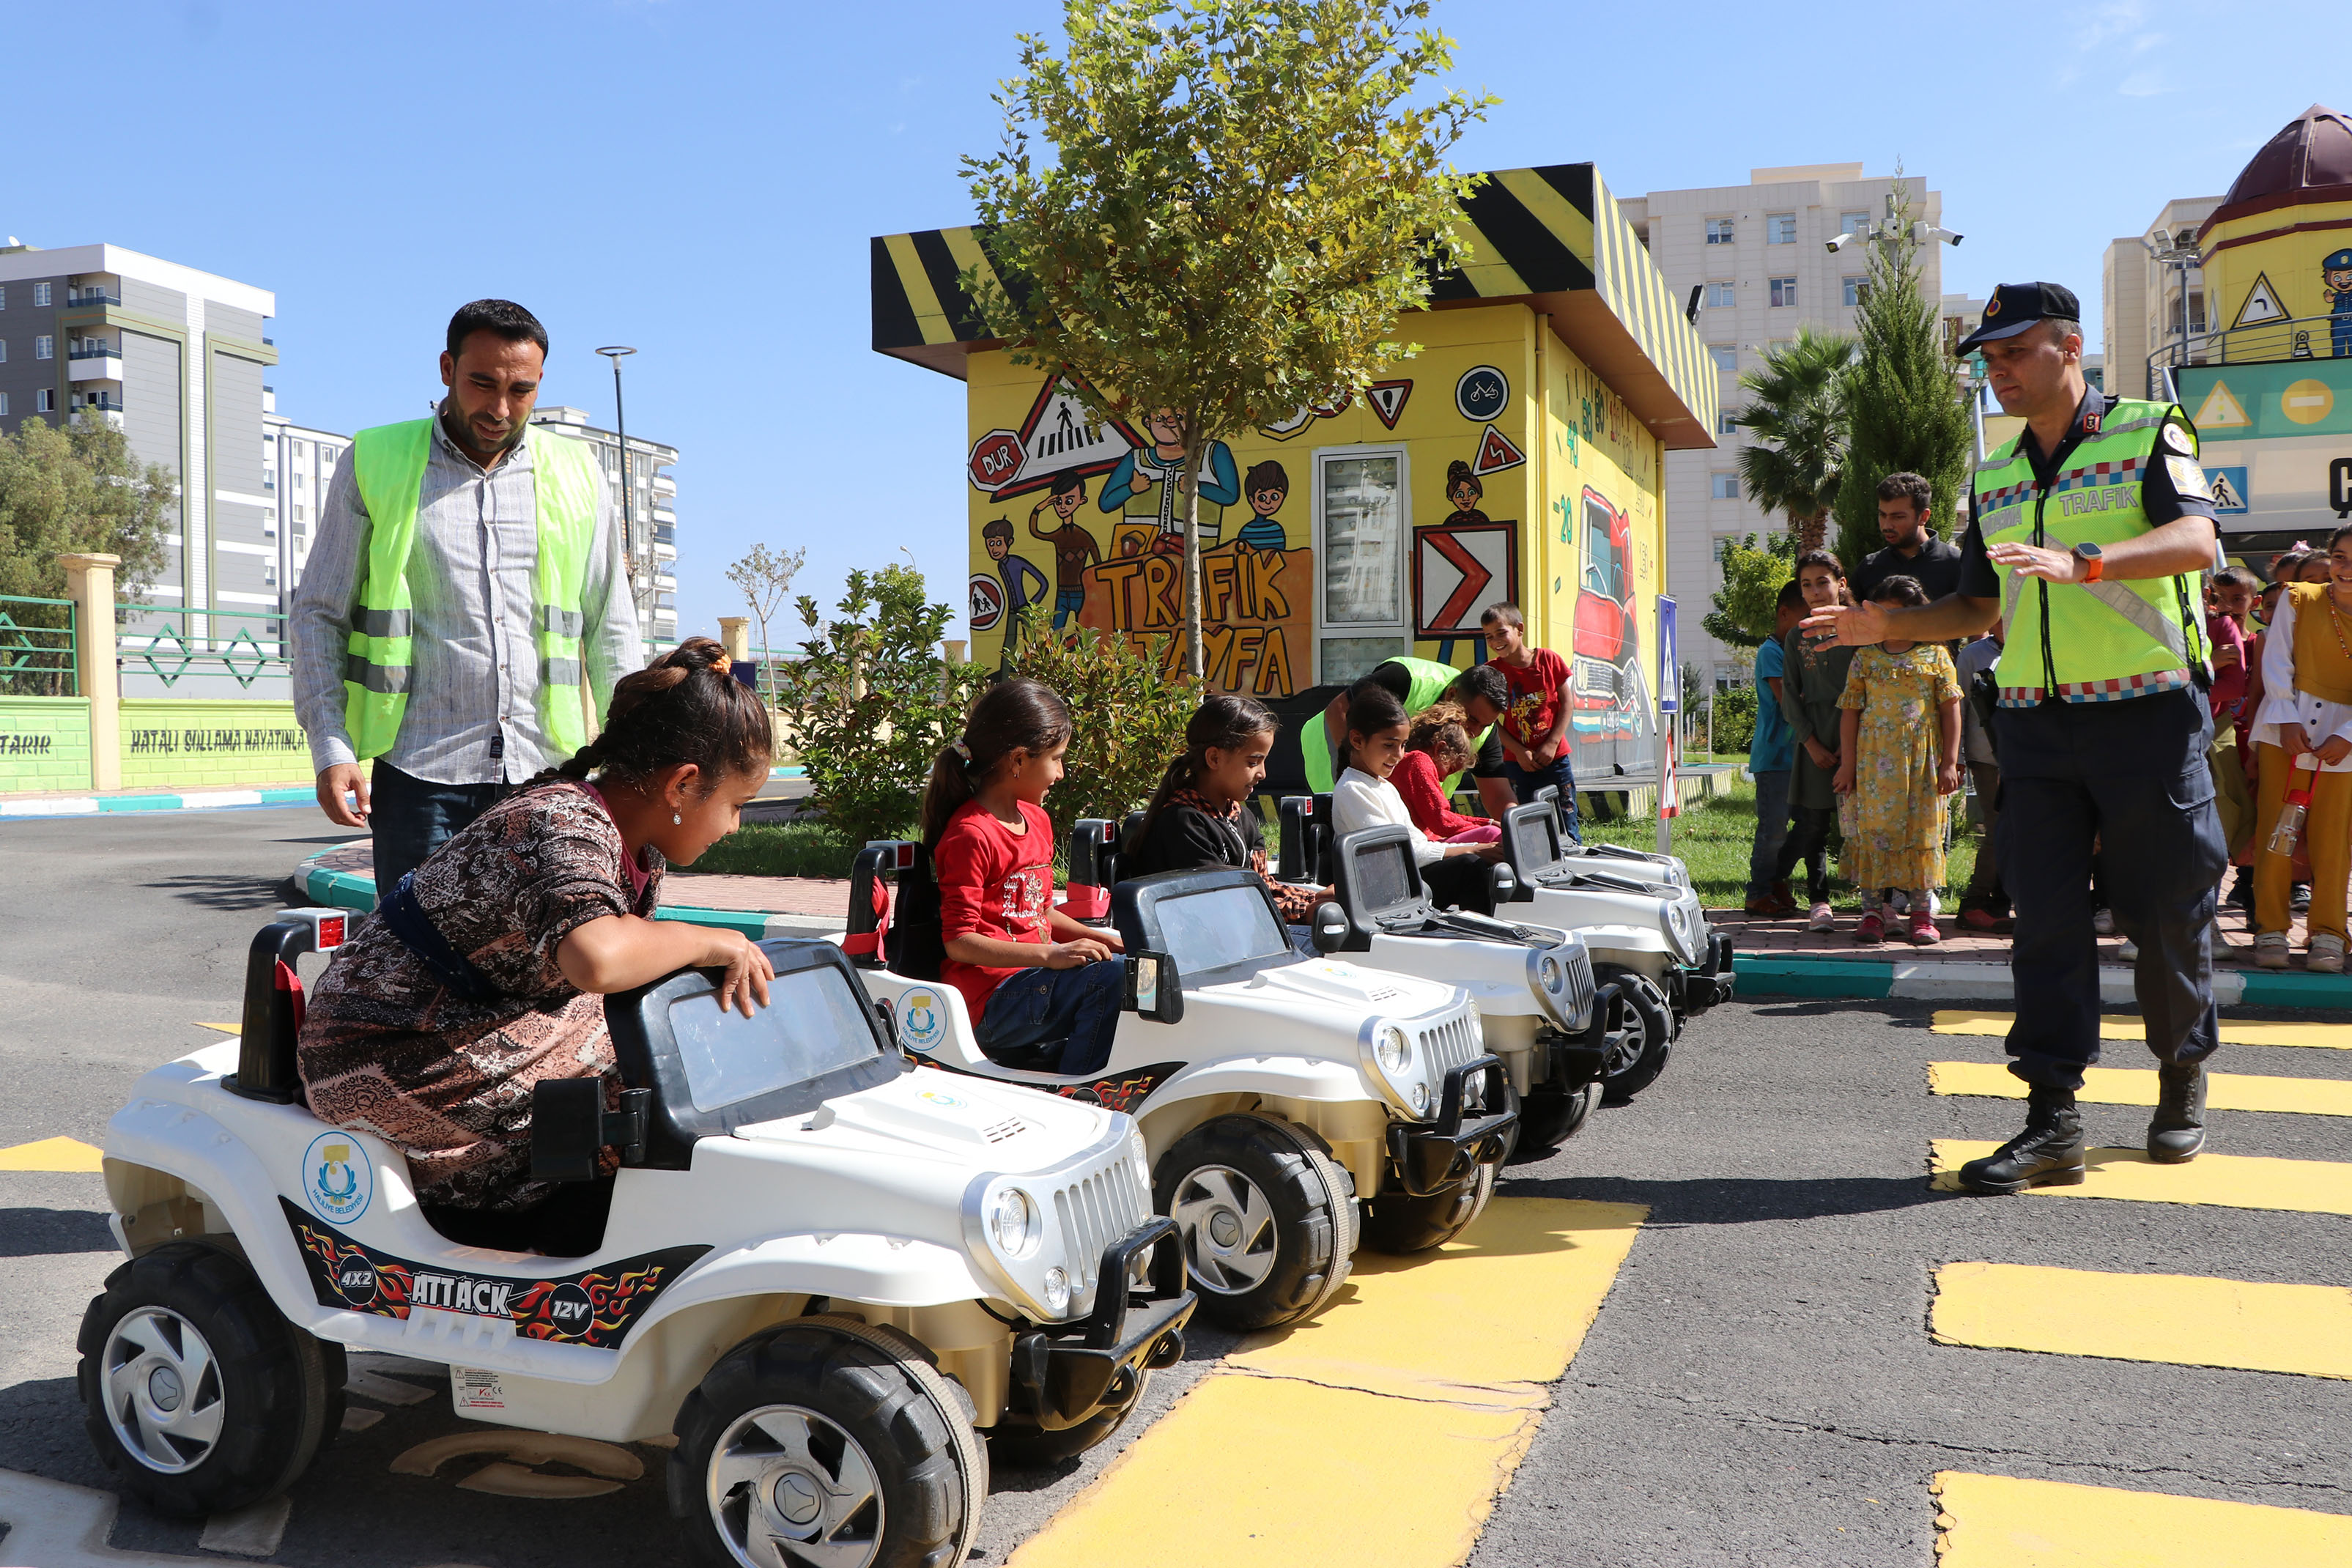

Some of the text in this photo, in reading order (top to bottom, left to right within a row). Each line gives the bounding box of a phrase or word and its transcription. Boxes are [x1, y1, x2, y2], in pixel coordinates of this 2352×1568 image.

[980, 444, 1015, 477] DUR
[1567, 420, 1578, 469] 40
[1561, 494, 1572, 544] 20
[130, 730, 178, 753] HATALI
[341, 1271, 590, 1320] 4X2 ATTACK 12V
